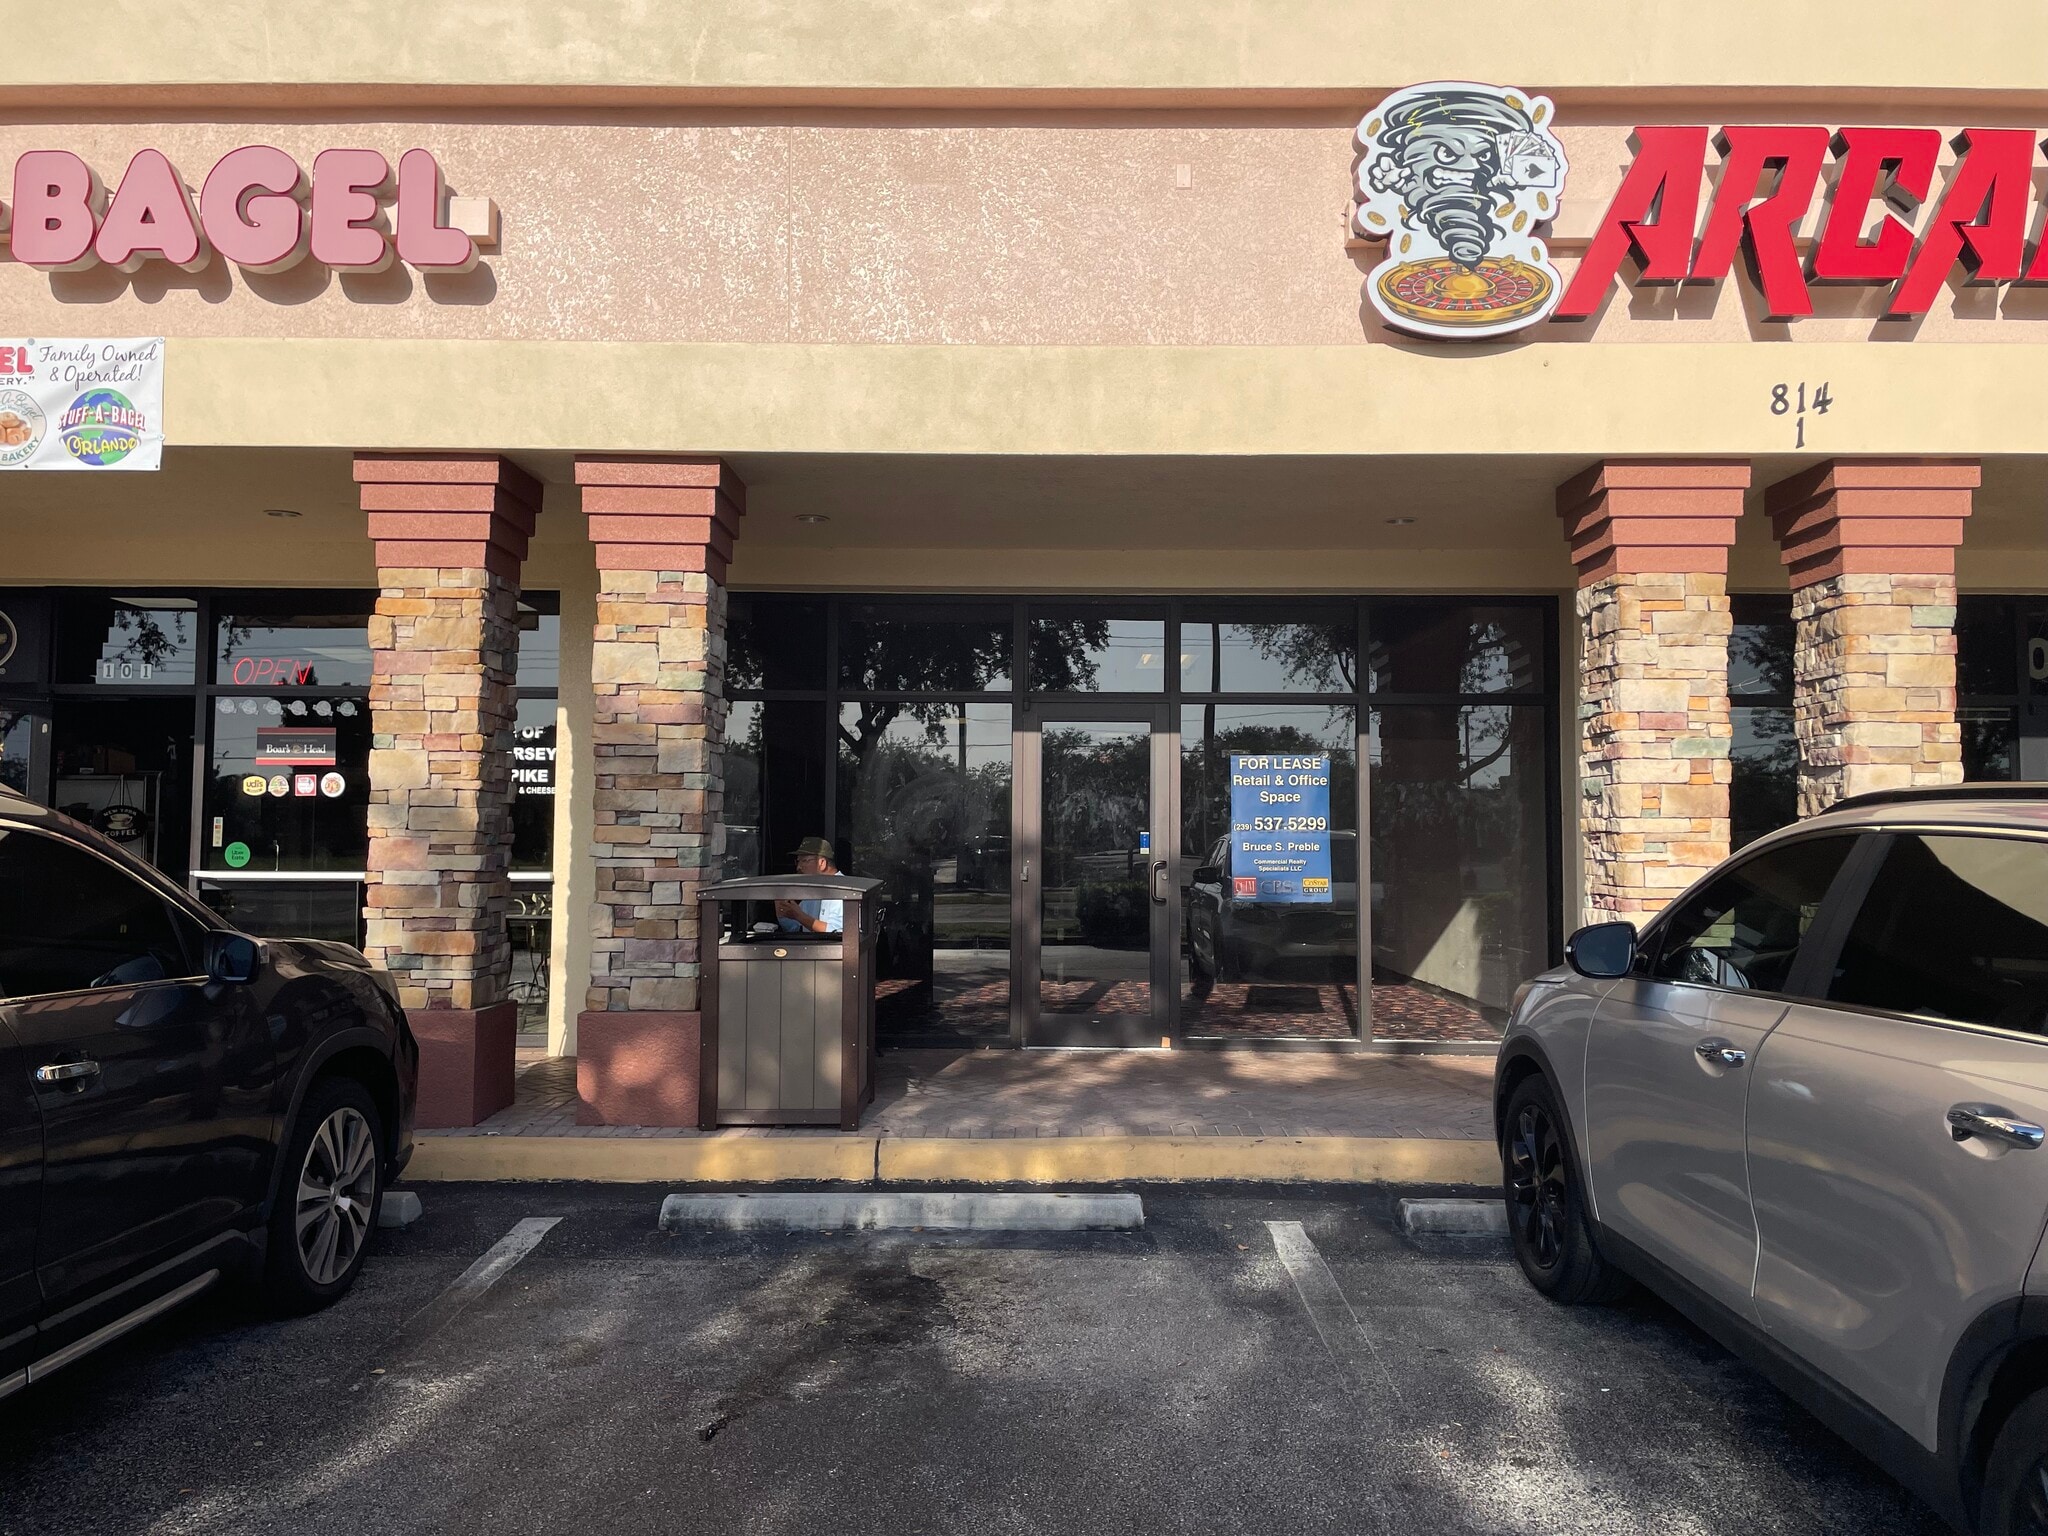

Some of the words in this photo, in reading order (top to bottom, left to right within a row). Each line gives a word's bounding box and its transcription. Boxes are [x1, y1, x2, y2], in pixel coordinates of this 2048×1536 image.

[11, 145, 474, 268] BAGEL
[1552, 126, 2048, 317] ARCA
[39, 344, 96, 369] Family
[102, 344, 157, 362] Owned
[50, 367, 59, 382] &
[64, 365, 143, 391] Operated!
[1770, 382, 1834, 416] 814
[57, 405, 147, 432] STUFF-A-BAGEL
[1795, 417, 1805, 448] 1
[1, 436, 39, 461] BAKERY
[66, 435, 138, 457] ORLANDO
[103, 664, 151, 679] 101
[233, 657, 313, 685] OPEN
[522, 726, 544, 739] OF
[266, 744, 291, 754] Boar's
[303, 744, 326, 754] Head
[506, 747, 557, 760] RSEY
[1239, 758, 1269, 770] FOR
[1273, 758, 1322, 770] LEASE
[1233, 775, 1271, 786] Retail
[1274, 775, 1284, 786] &
[1288, 775, 1328, 786] Office
[519, 786, 525, 794] &
[1260, 791, 1301, 804] Space
[1233, 823, 1252, 831] (239)
[1254, 817, 1327, 831] 537.5299
[1242, 842, 1272, 851] Bruce
[1275, 842, 1285, 851] S.
[1288, 842, 1320, 851] Preble
